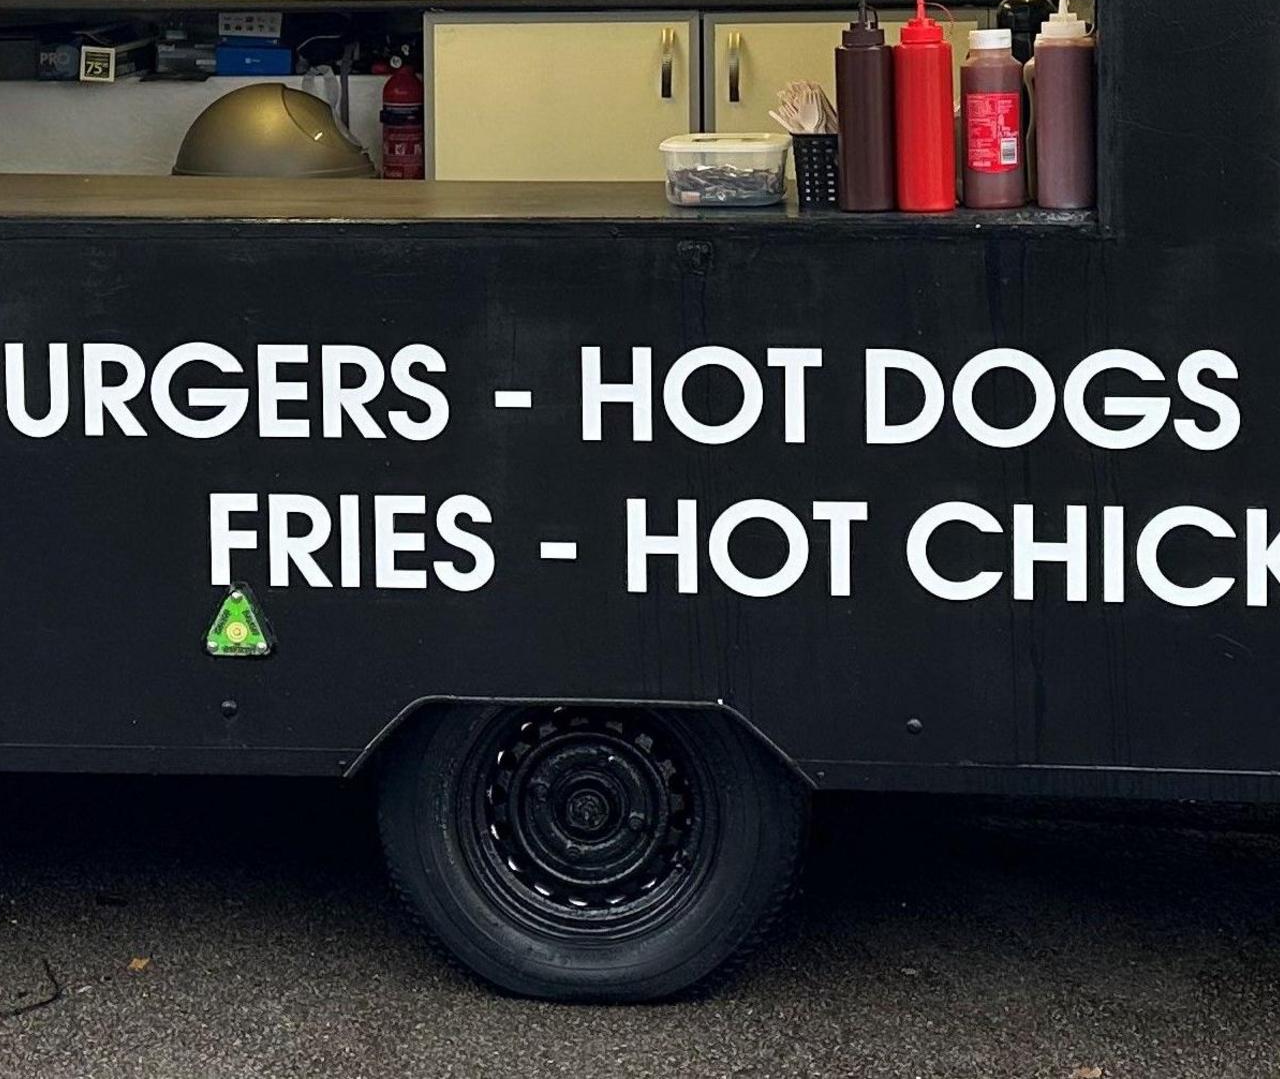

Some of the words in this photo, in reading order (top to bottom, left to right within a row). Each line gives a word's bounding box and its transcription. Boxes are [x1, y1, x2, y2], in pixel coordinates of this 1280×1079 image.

[581, 345, 823, 445] HOT
[866, 347, 1241, 451] DOGS
[209, 492, 496, 592] FRIES
[626, 498, 870, 597] HOT
